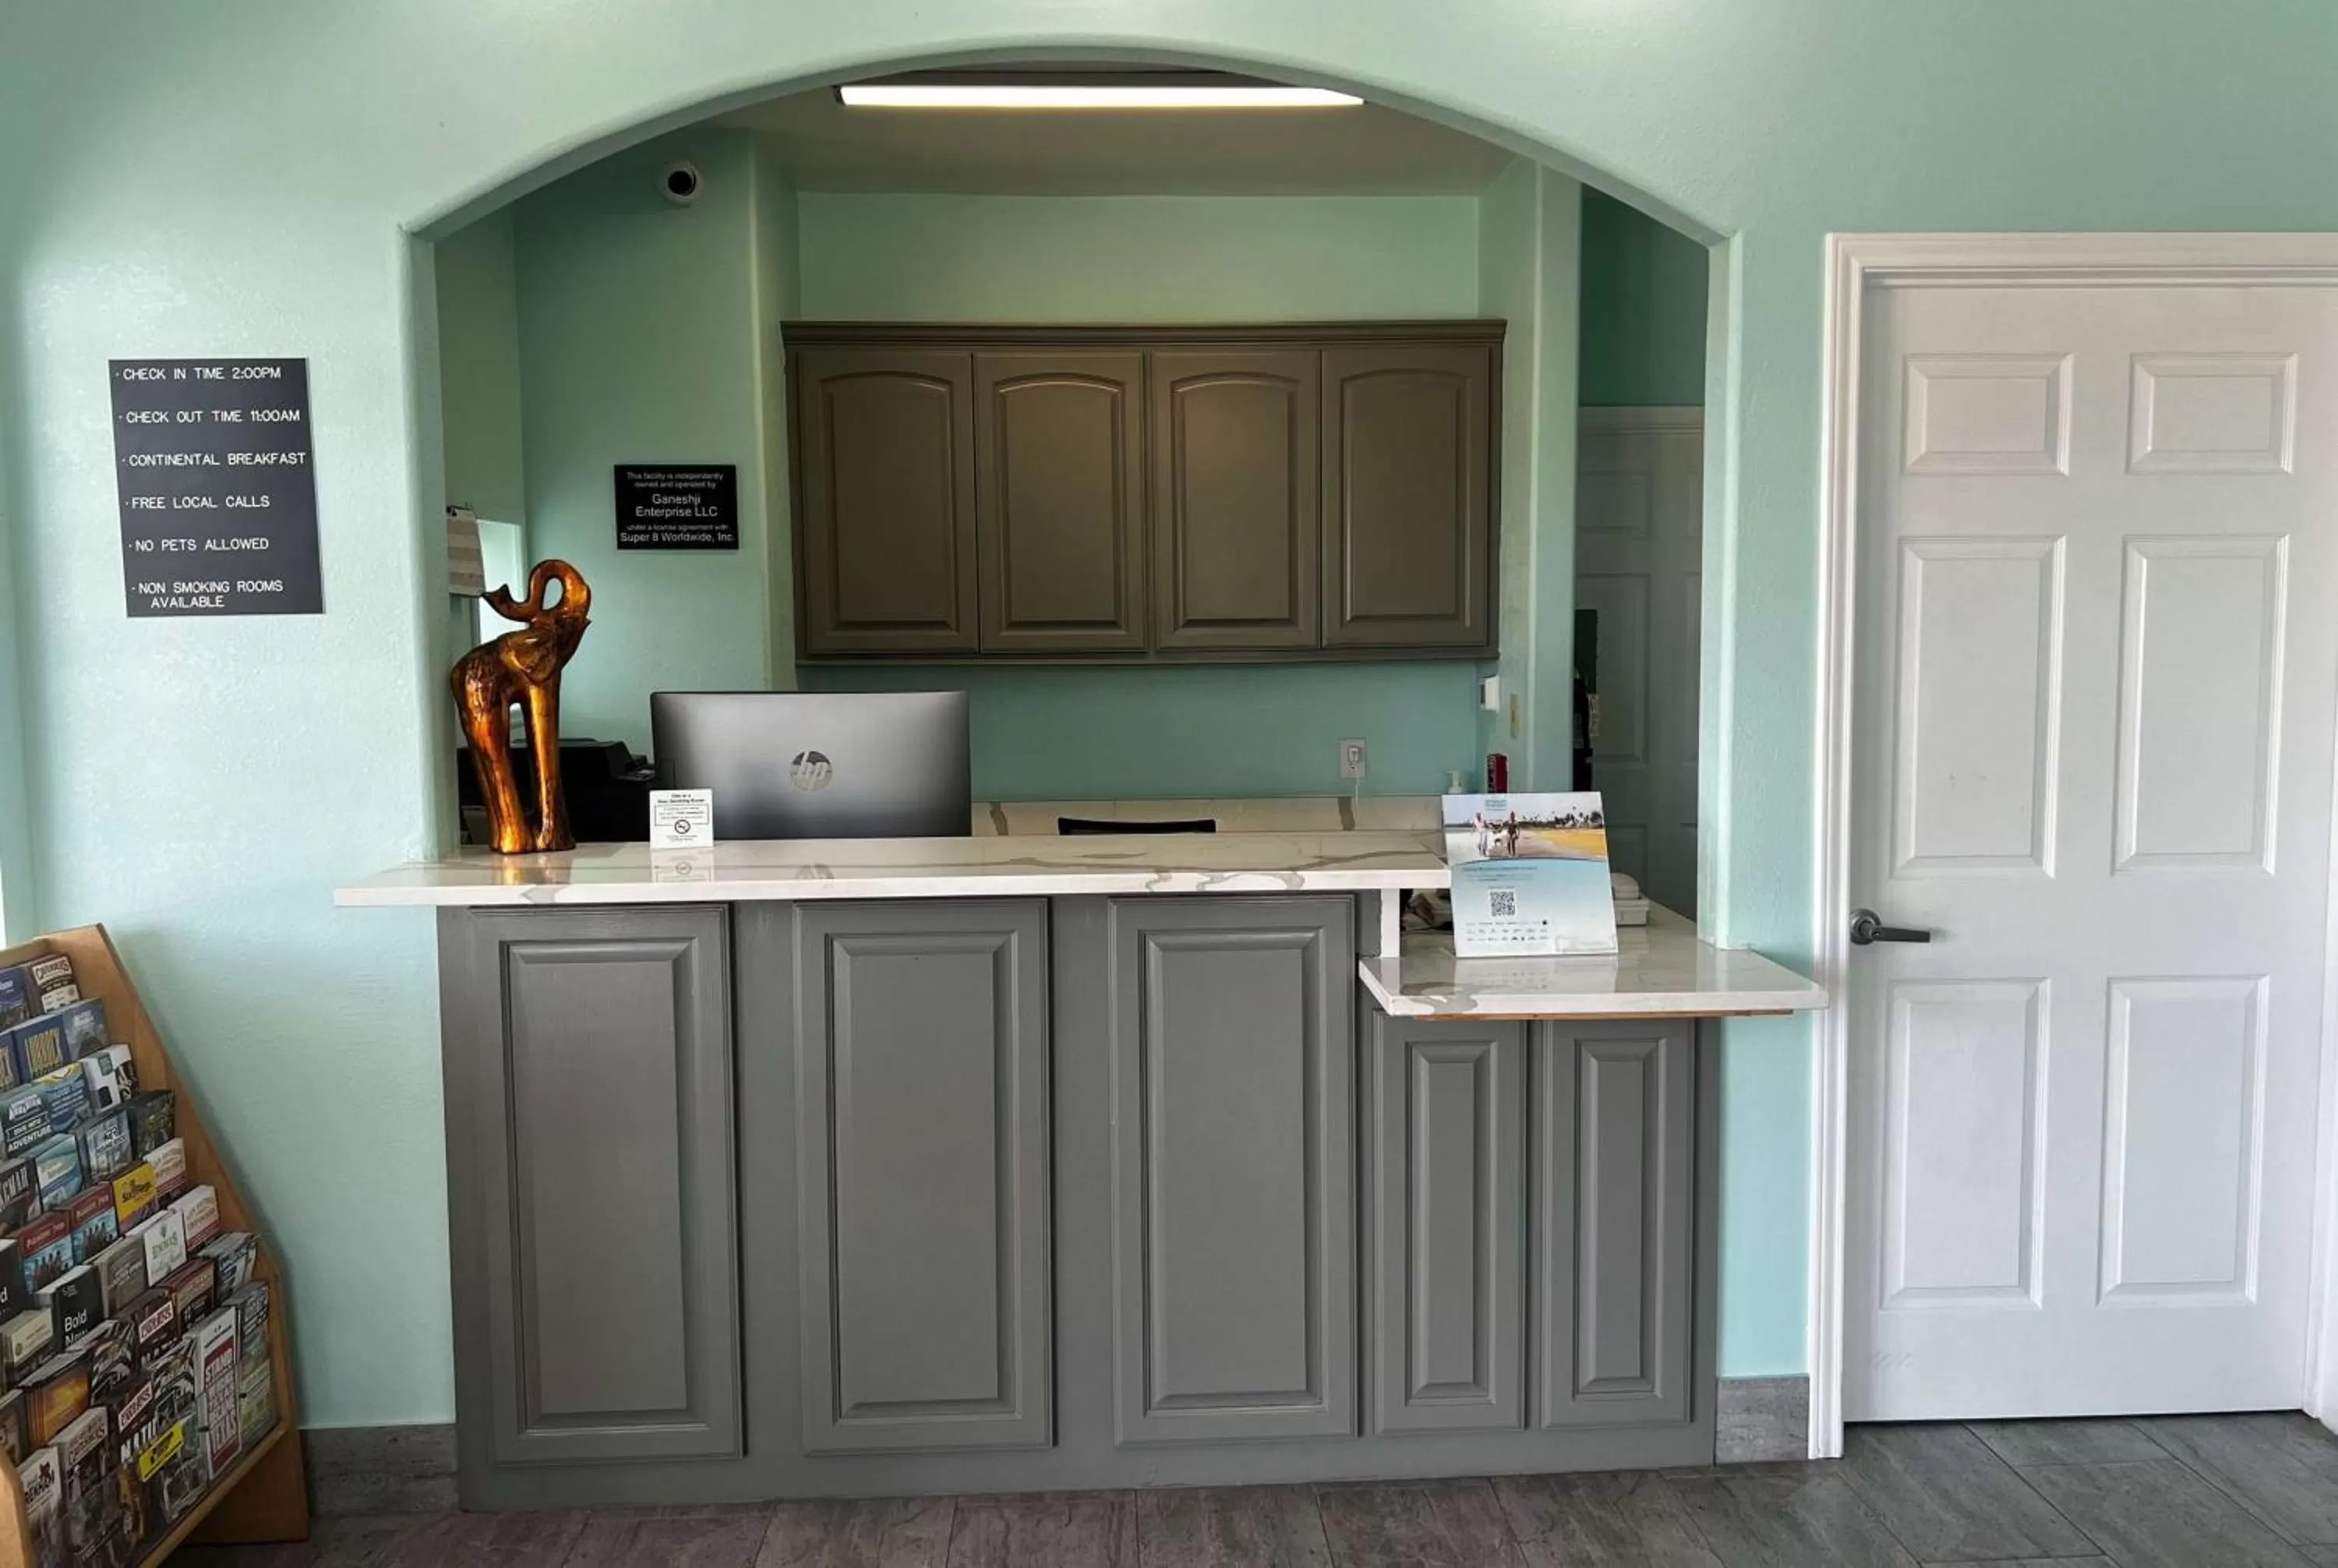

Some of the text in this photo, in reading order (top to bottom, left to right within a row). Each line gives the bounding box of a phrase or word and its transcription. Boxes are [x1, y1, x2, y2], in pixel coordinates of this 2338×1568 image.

[122, 367, 281, 380] CHECK IN TIME 2:00PM
[125, 410, 300, 424] CHECK OUT TIME 11:00AM
[129, 452, 306, 467] CONTINENTAL BREAKFAST
[132, 496, 270, 510] FREE LOCAL CALLS
[635, 506, 718, 519] Enterprise LLC
[620, 532, 650, 544] Super
[652, 532, 659, 542] 8
[661, 532, 715, 543] Worldwide,
[135, 538, 269, 553] NO PETS ALLOWED
[139, 579, 284, 595] NON SMOKING ROOMS
[150, 595, 225, 609] AVAILABLE
[793, 748, 831, 792] hp
[8, 1125, 53, 1153] ADVENTURE
[65, 1309, 87, 1332] Bold
